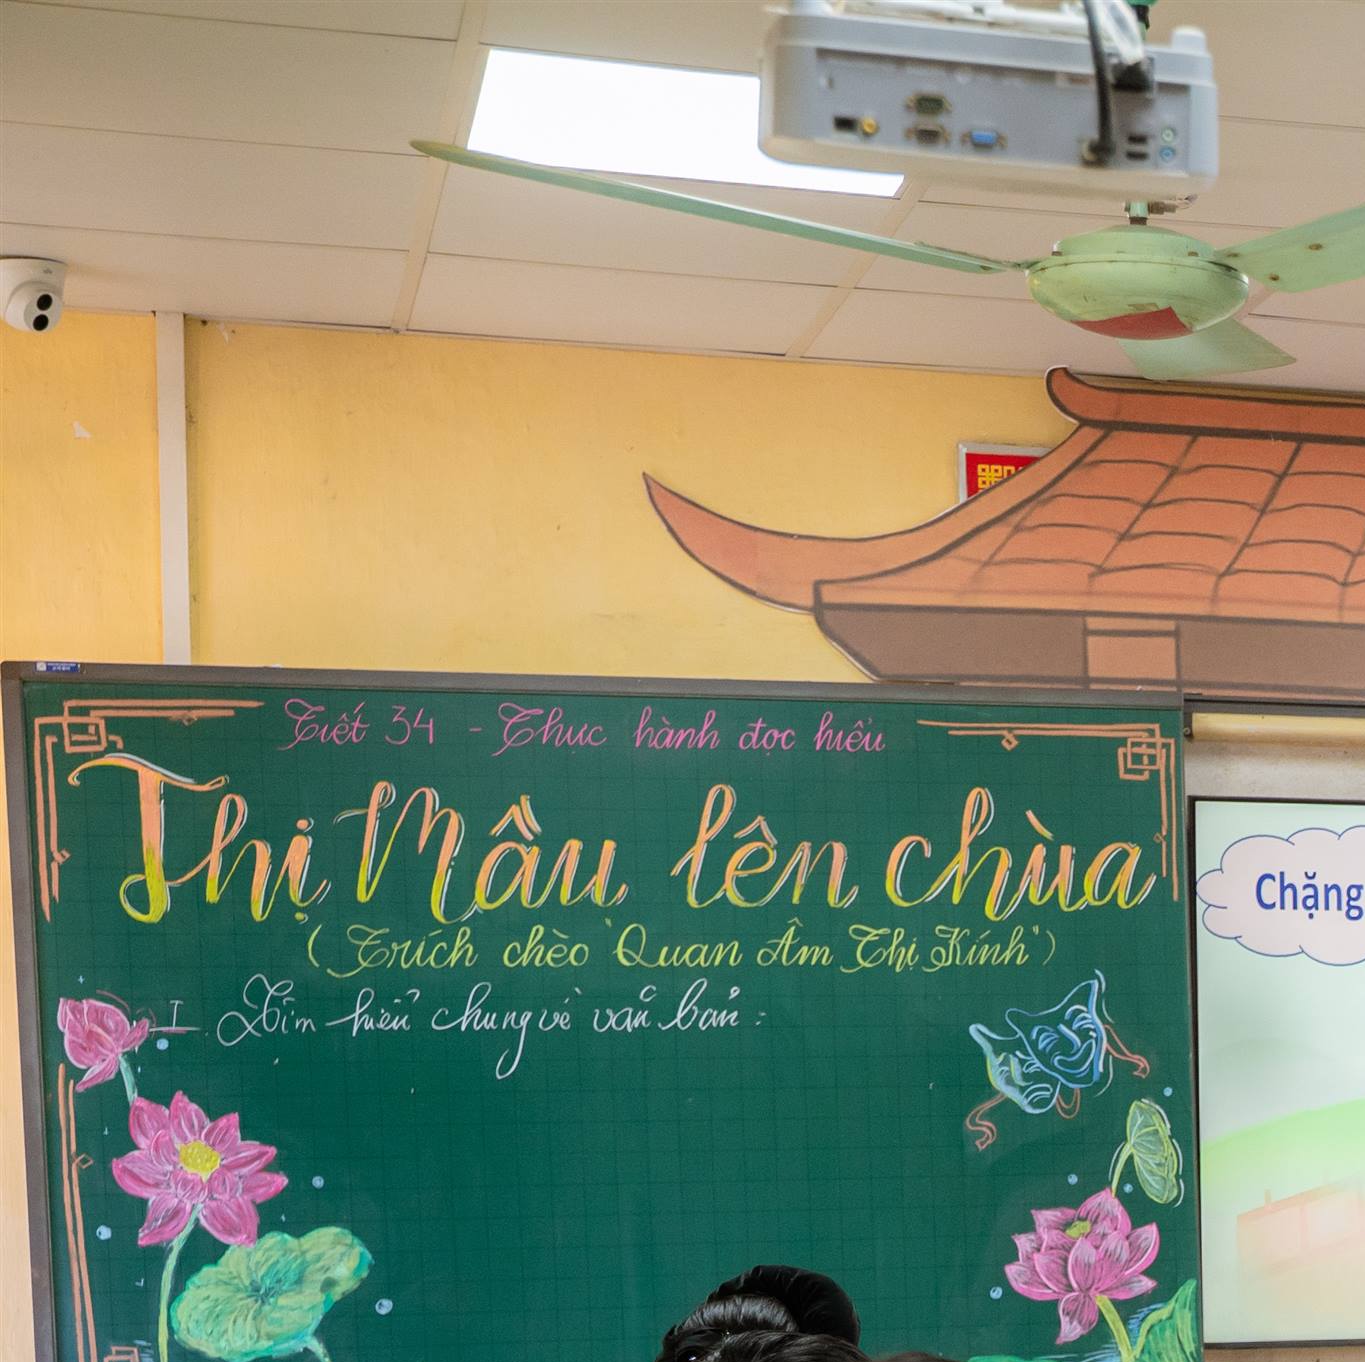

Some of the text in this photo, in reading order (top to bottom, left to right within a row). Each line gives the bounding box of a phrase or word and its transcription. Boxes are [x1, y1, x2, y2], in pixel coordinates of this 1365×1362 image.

[385, 705, 434, 745] 34
[633, 705, 721, 750] hành
[738, 717, 796, 756] đọc
[67, 753, 331, 924] Thị
[671, 783, 859, 908] lên
[886, 787, 1157, 922] chùa
[1255, 871, 1364, 921] Chặng
[503, 924, 589, 968] chèo
[756, 916, 834, 967] Âm
[839, 924, 919, 973] Thị
[431, 982, 529, 1080] chung
